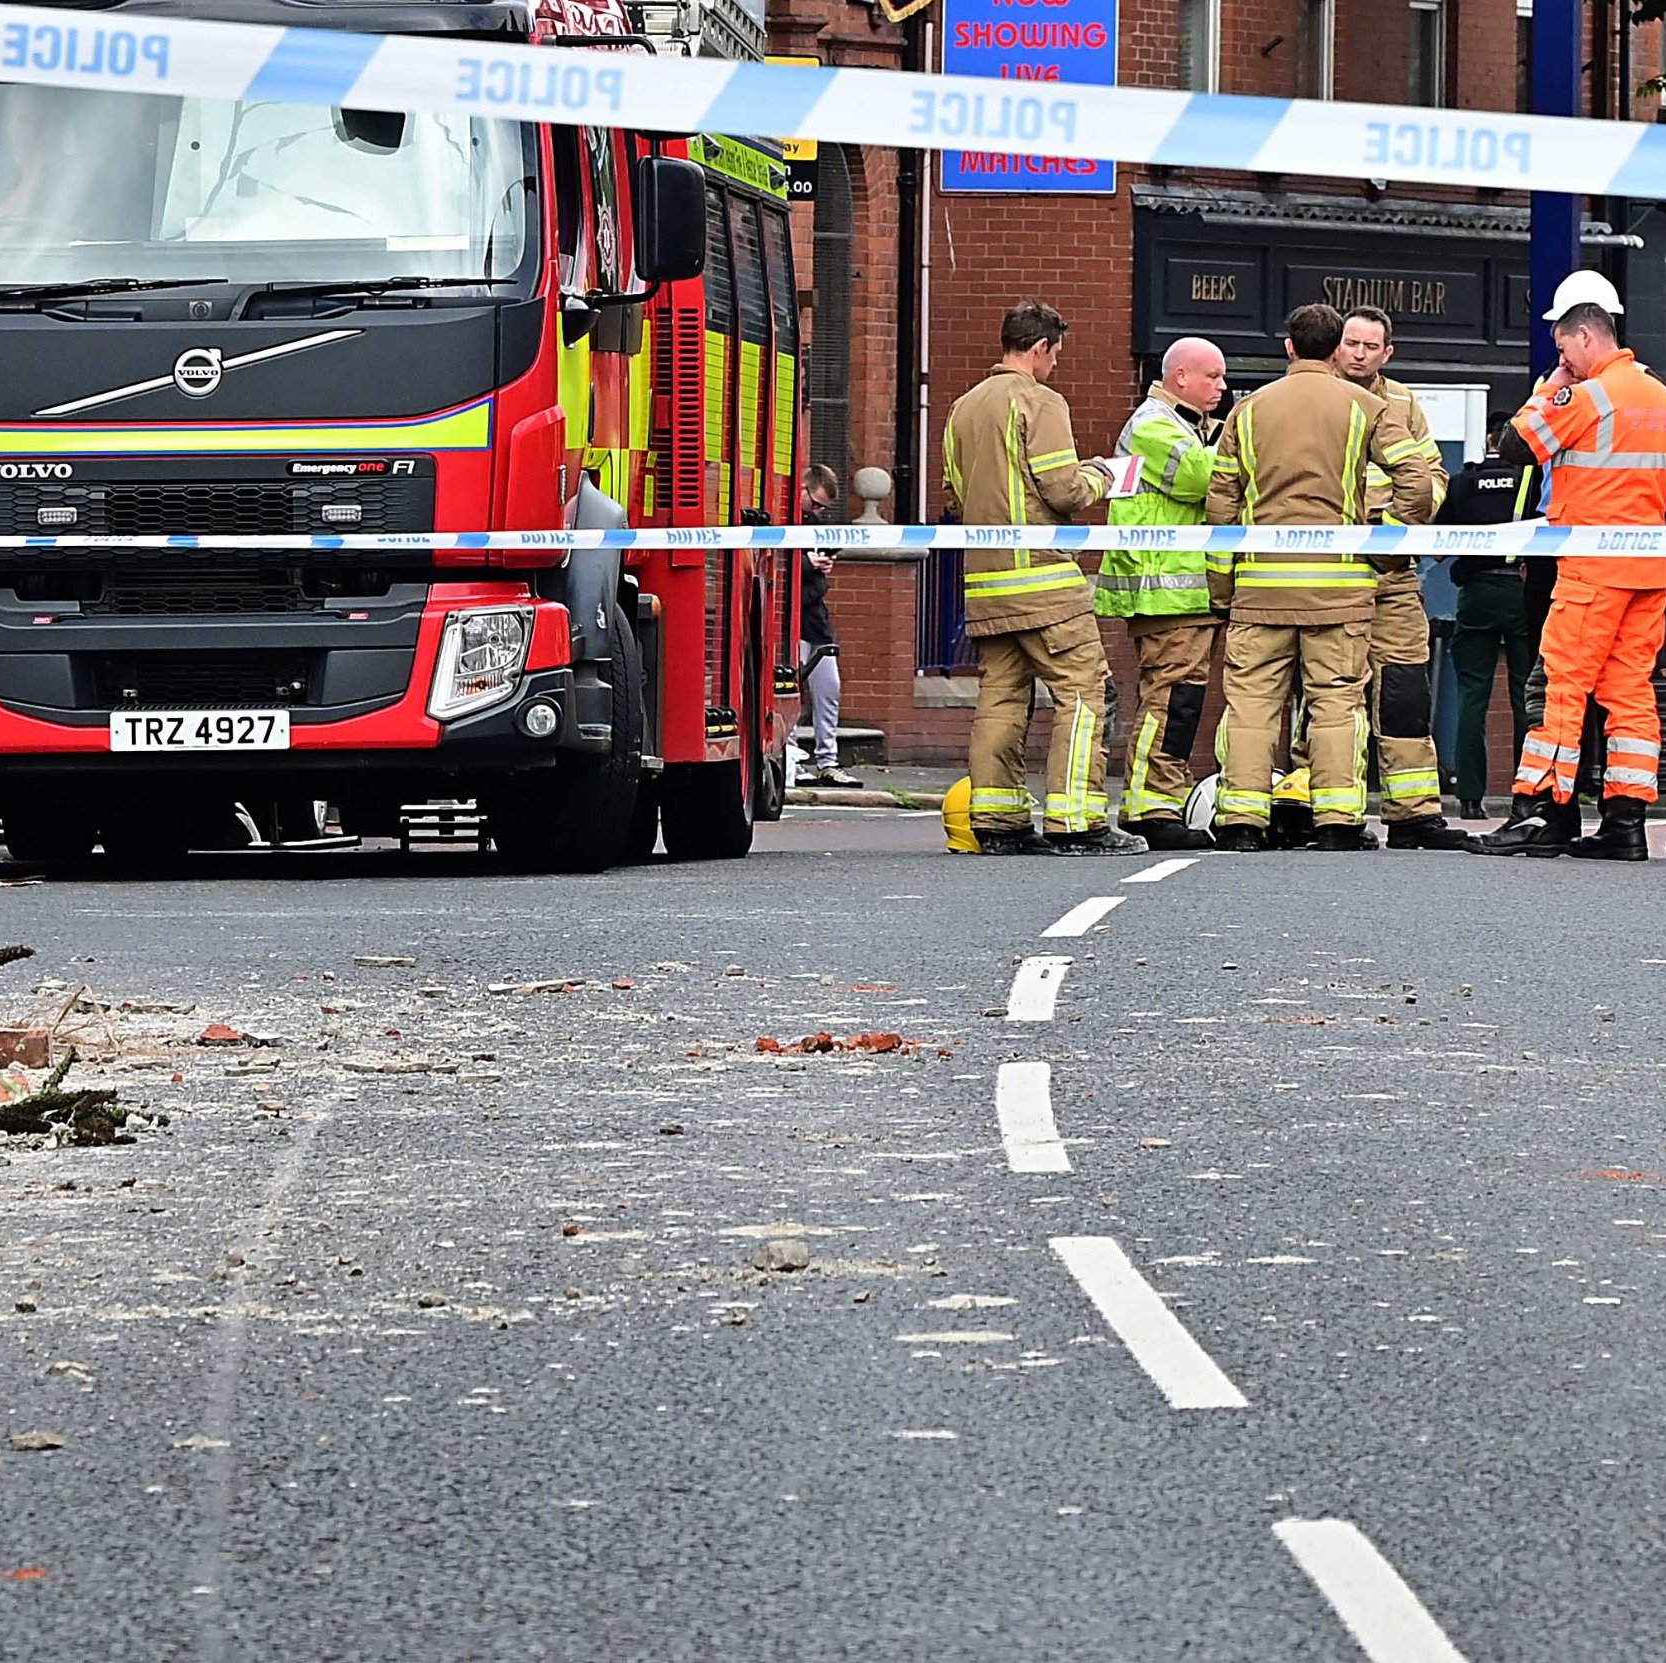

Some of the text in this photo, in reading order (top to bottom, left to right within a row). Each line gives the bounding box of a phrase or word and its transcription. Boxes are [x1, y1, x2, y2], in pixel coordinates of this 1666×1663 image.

[954, 22, 1109, 49] SHOWING
[960, 151, 1097, 175] MATCHES
[1191, 274, 1237, 302] BEERS
[1323, 276, 1448, 315] STADIUM BAR
[177, 369, 219, 377] VOLVO
[292, 461, 385, 475] Emergency one
[1478, 478, 1514, 490] POLICE
[125, 716, 276, 745] TRZ 4927
